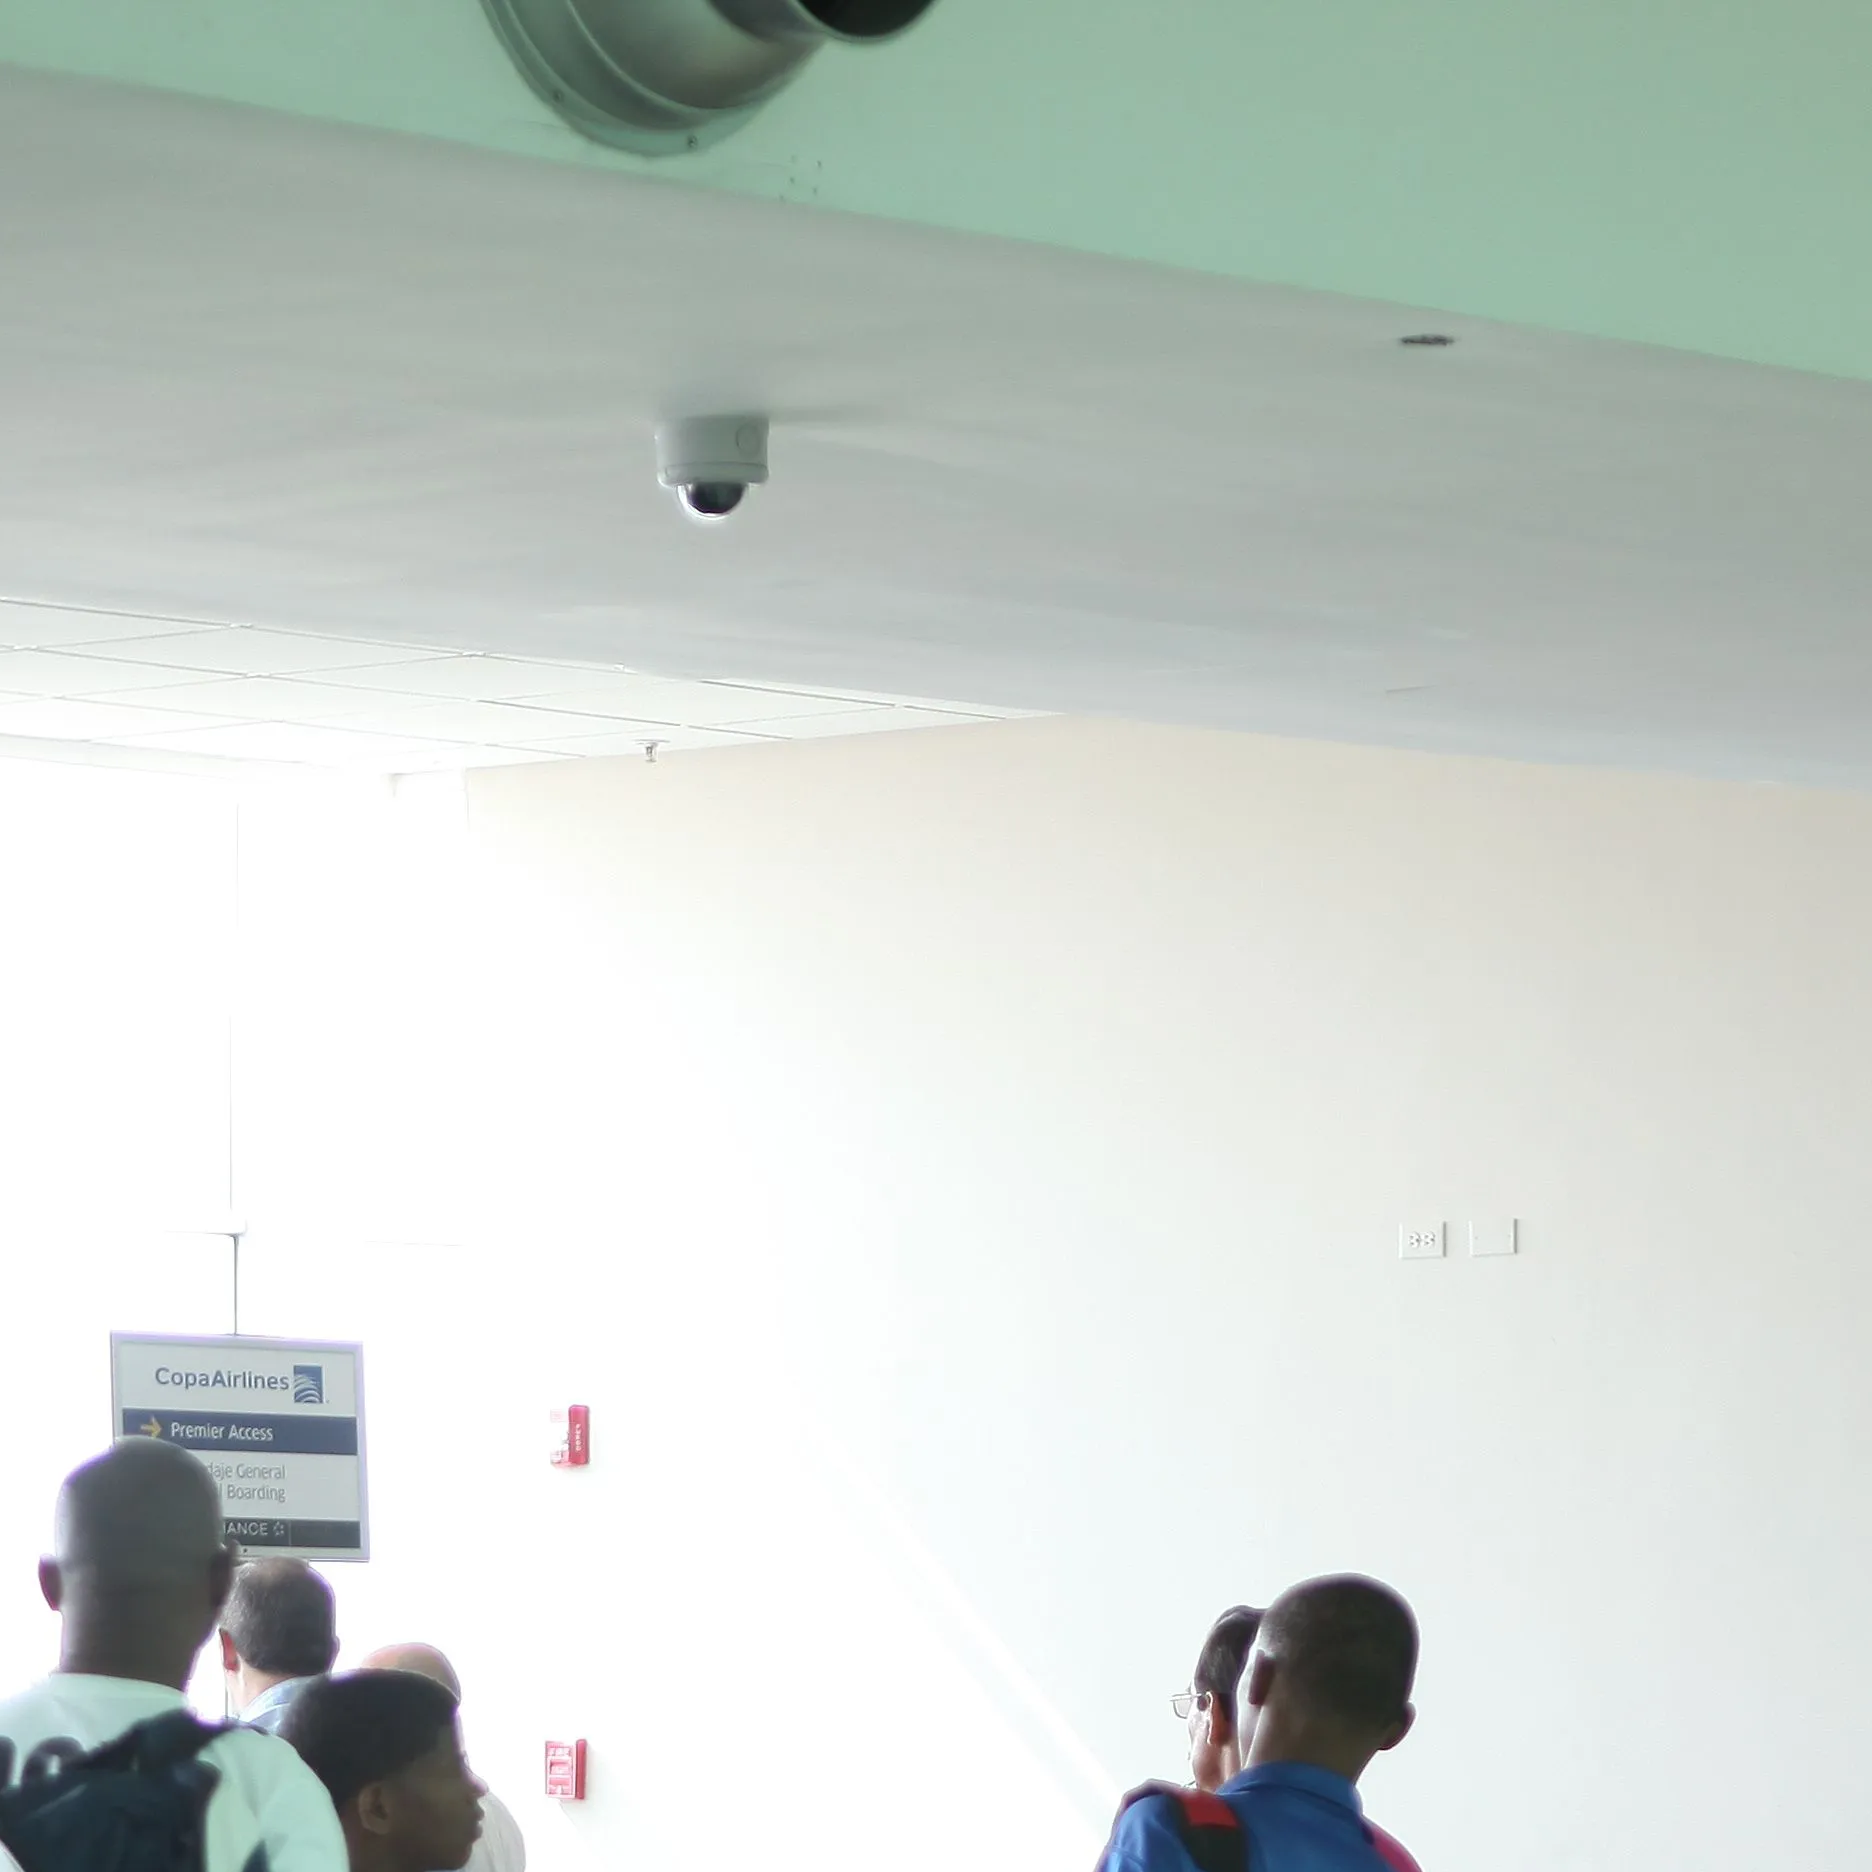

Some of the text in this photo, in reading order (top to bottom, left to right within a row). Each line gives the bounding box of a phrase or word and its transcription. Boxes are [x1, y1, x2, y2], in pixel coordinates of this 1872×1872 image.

[154, 1366, 290, 1391] CopaAirlines
[170, 1421, 274, 1442] Premier Access
[207, 1461, 286, 1481] daje General
[227, 1483, 286, 1503] Boarding
[223, 1521, 269, 1536] IANCE
